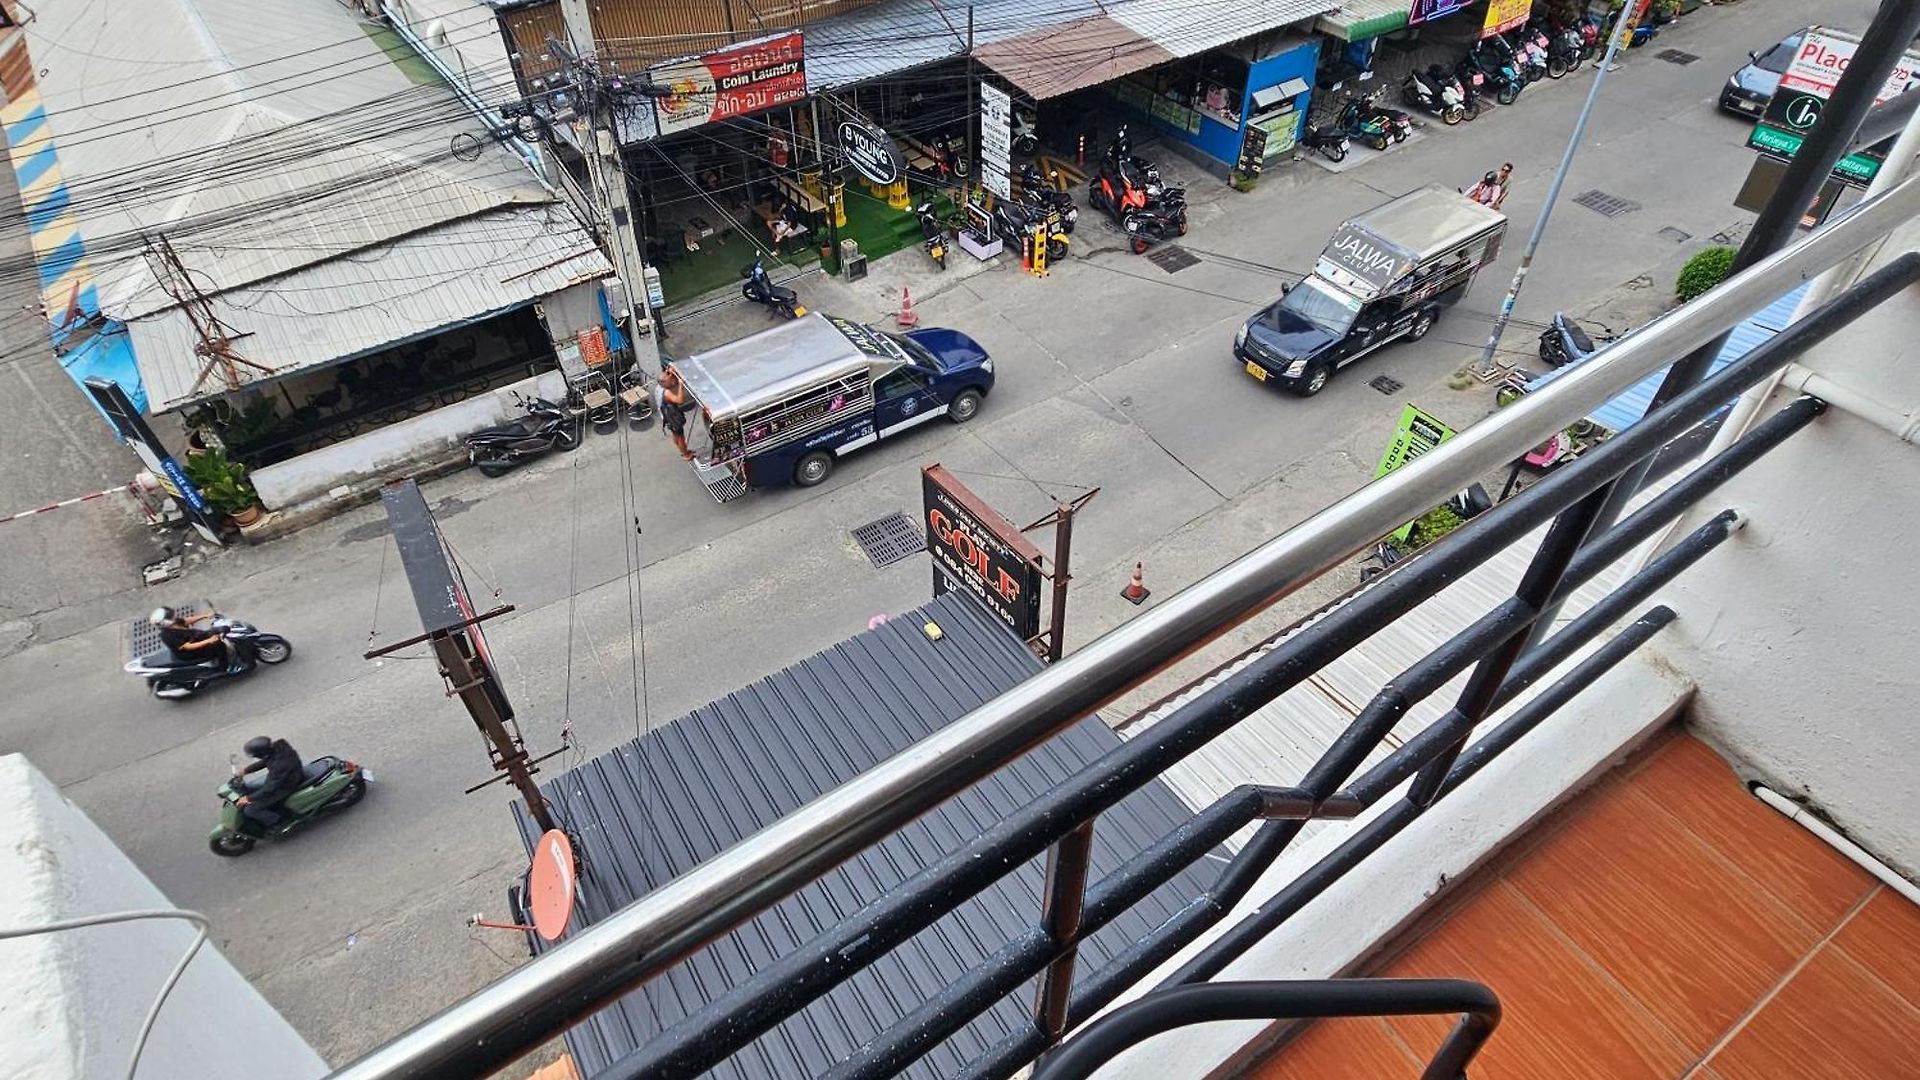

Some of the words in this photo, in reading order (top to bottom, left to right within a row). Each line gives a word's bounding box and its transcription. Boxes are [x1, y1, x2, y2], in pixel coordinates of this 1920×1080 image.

[1800, 44, 1851, 71] Plac
[722, 74, 750, 89] Coin
[752, 61, 799, 84] Laundry
[845, 125, 852, 141] B
[853, 130, 888, 165] YOUNG
[1334, 234, 1396, 276] JALWA
[1343, 255, 1370, 273] CLUB
[959, 520, 987, 551] PLAY
[930, 508, 1020, 604] GOLF
